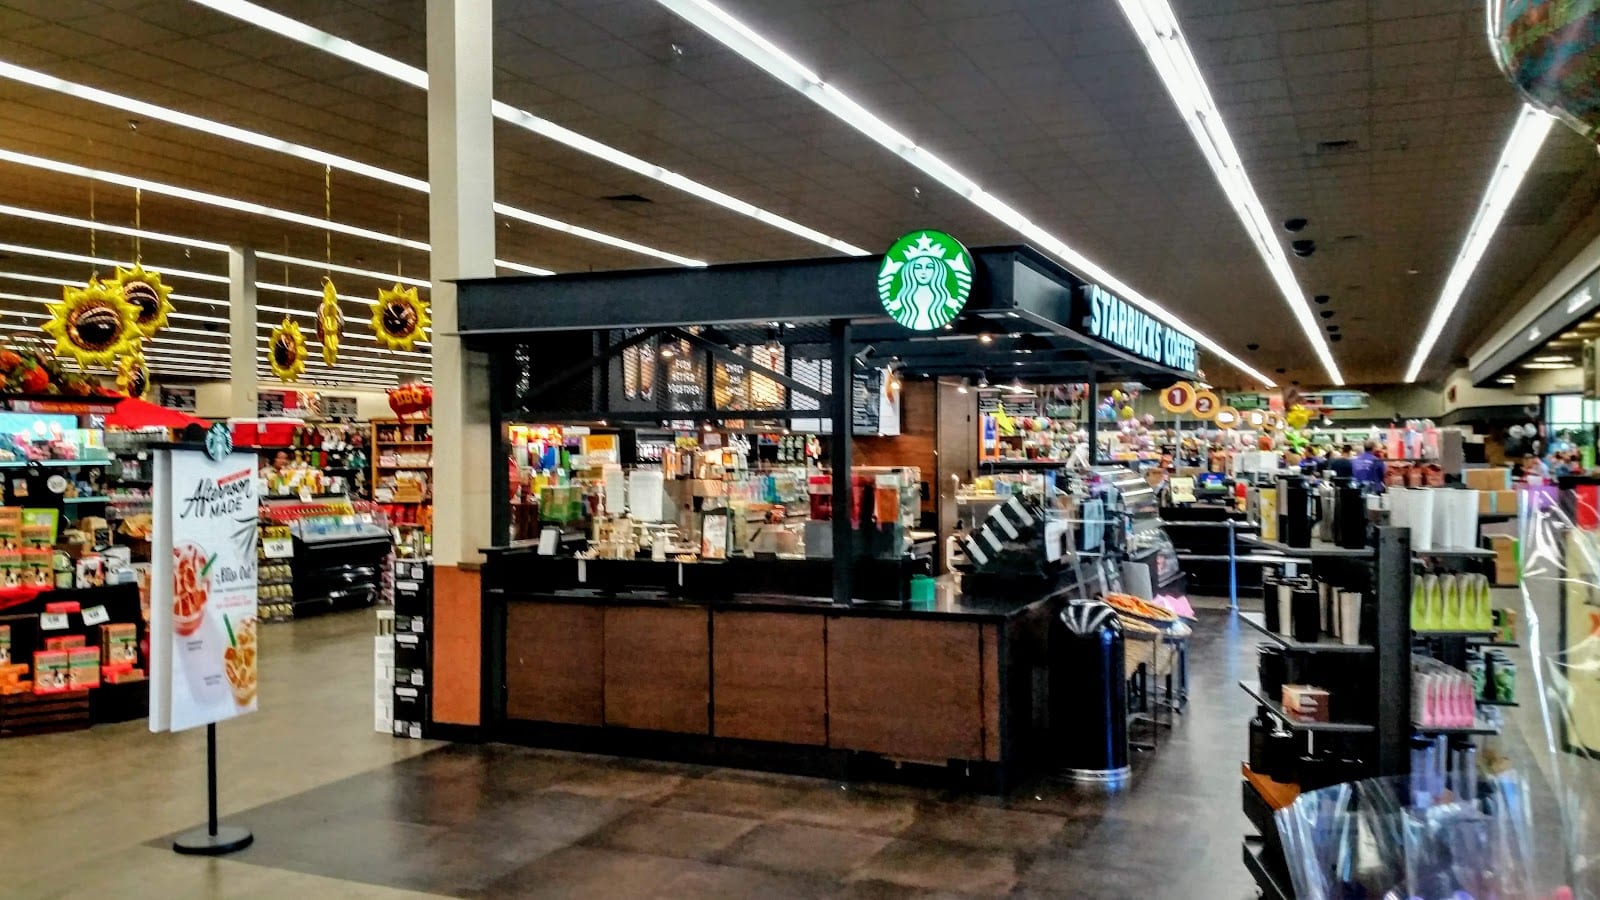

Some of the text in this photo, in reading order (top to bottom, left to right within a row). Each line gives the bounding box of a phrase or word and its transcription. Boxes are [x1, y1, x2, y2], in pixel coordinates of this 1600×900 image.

[1091, 284, 1196, 373] STARBUCKS COFFEE
[1172, 389, 1182, 406] 1
[1199, 399, 1211, 412] 2
[180, 478, 253, 519] Afternoon
[210, 497, 242, 519] MADE
